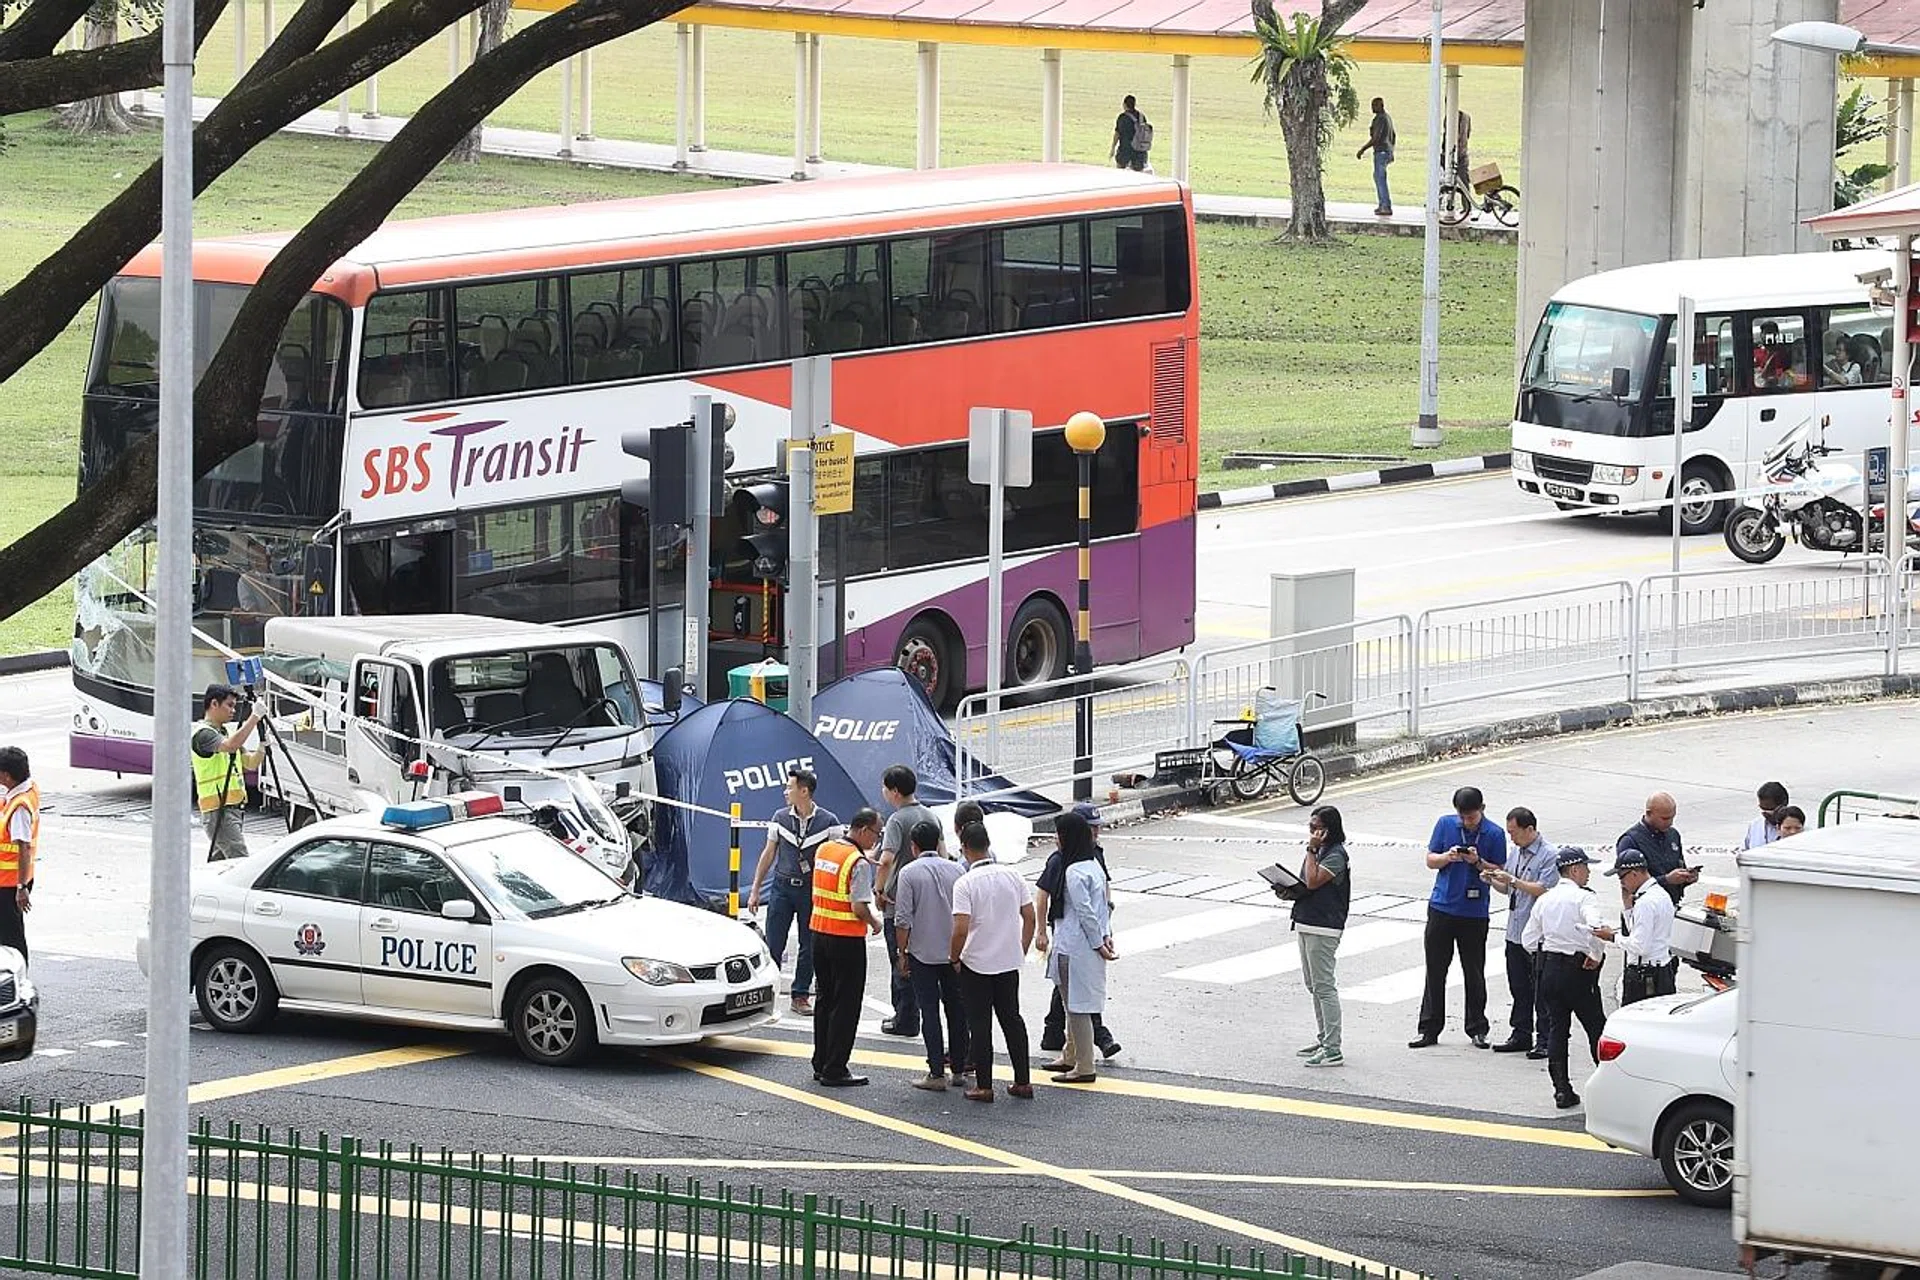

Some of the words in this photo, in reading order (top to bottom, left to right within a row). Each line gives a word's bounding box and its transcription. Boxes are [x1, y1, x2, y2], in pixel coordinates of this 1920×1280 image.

[361, 442, 432, 500] SBS
[429, 420, 597, 500] Transit
[813, 715, 900, 741] POLICE
[723, 756, 817, 795] POLICE
[381, 936, 477, 975] POLICE
